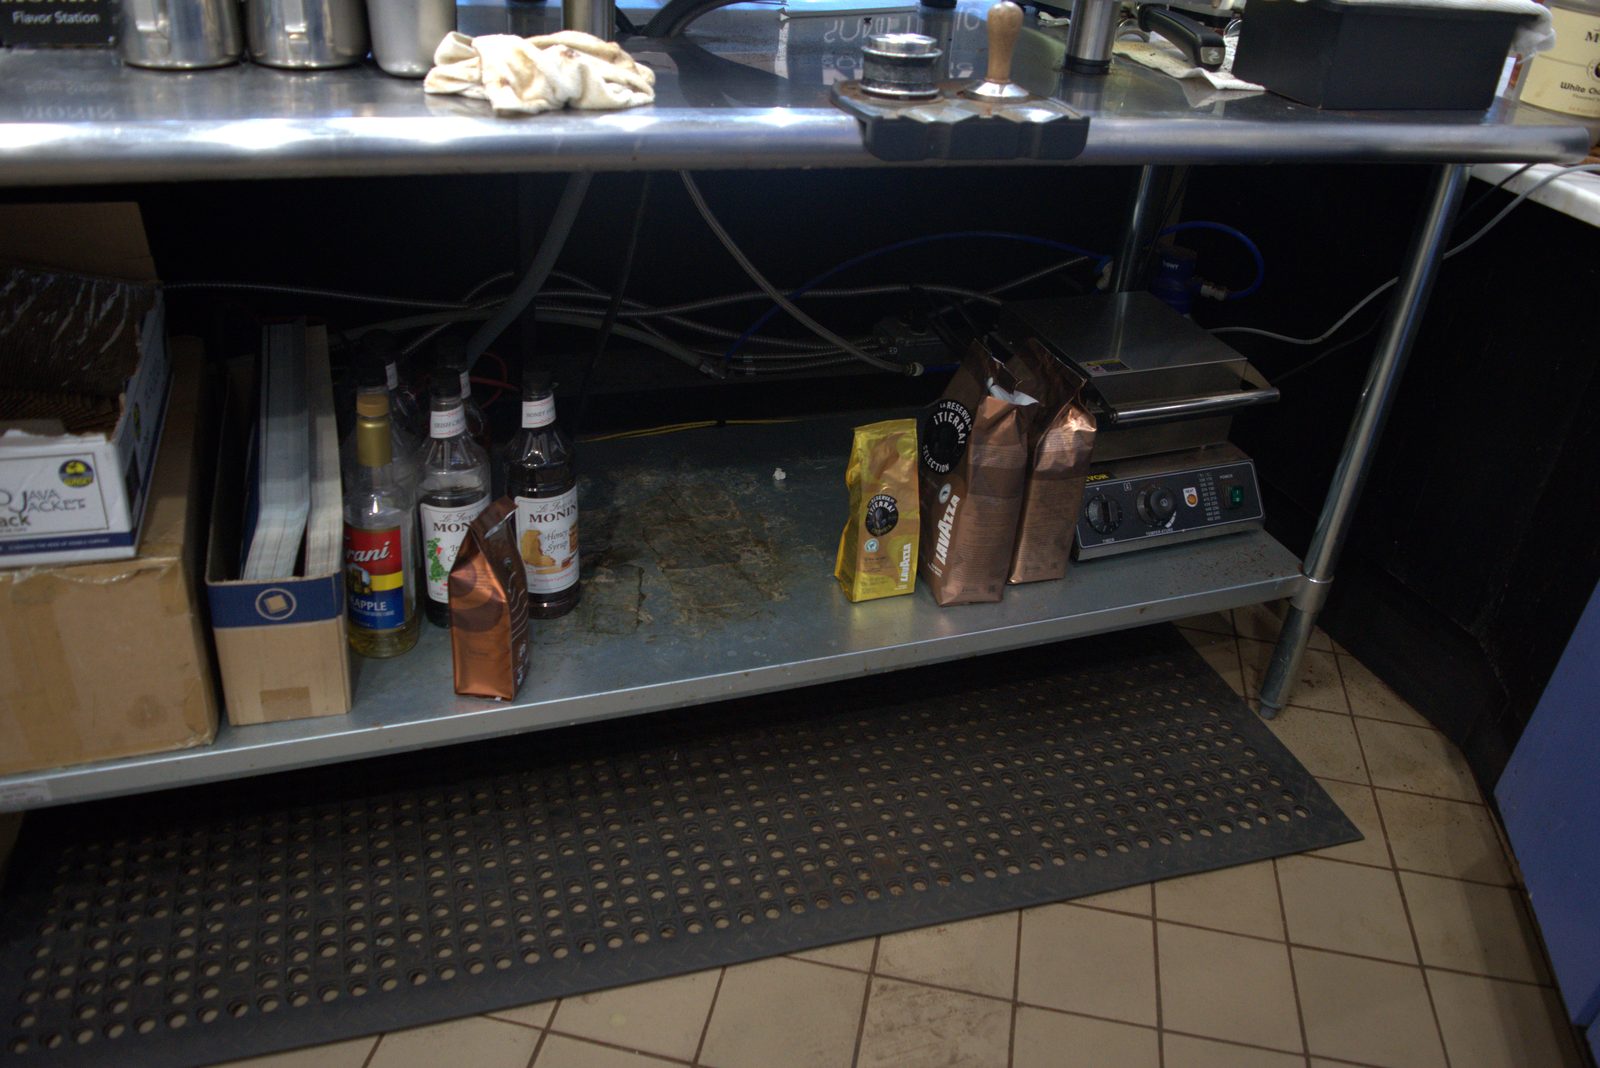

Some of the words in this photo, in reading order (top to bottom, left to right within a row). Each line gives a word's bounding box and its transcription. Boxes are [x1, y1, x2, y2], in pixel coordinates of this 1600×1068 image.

[12, 10, 52, 24] Flavor
[54, 10, 100, 24] Station
[1560, 81, 1586, 94] White
[946, 401, 971, 425] RESERVA
[922, 444, 950, 473] SELECTION
[0, 512, 31, 527] ack
[529, 504, 577, 524] MONIN
[433, 522, 471, 533] MON
[935, 494, 961, 566] LAVAZZA
[544, 530, 569, 541] Honey
[345, 540, 391, 562] rani
[544, 541, 569, 554] Syrup
[351, 598, 388, 612] APPLE
